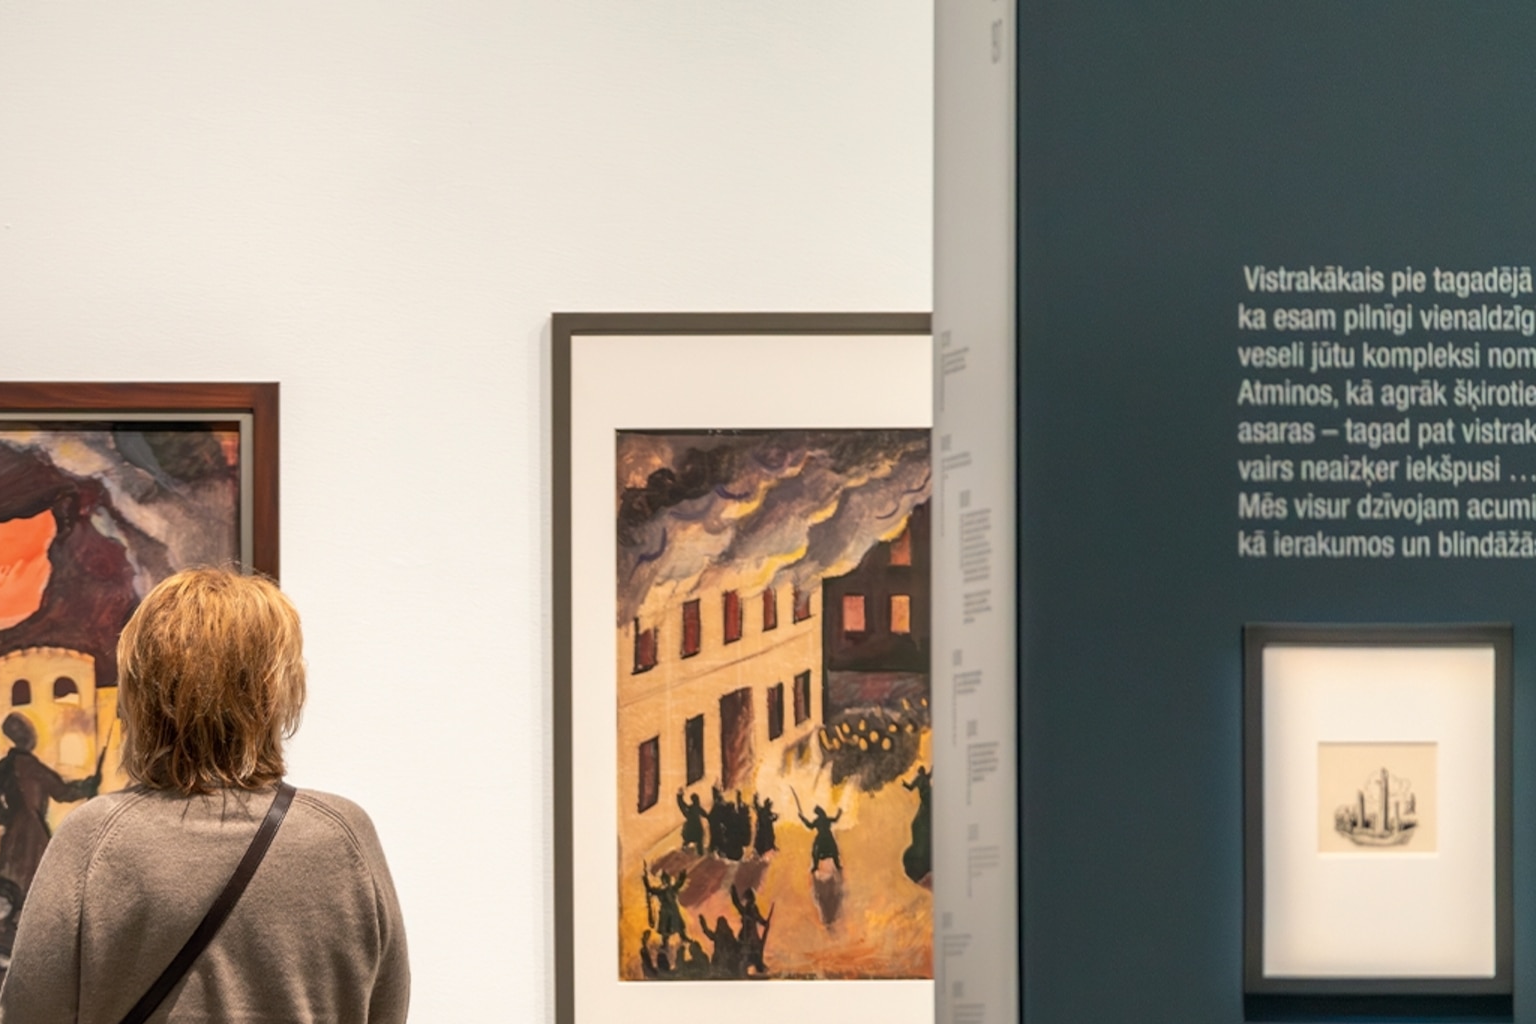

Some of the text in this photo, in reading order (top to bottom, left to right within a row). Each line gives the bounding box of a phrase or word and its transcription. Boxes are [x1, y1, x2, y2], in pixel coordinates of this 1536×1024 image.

[1244, 265, 1533, 298] Vistrakākais pie tagadējā
[1238, 303, 1266, 330] ka
[1273, 308, 1336, 330] esam
[1344, 303, 1412, 336] pilnīgi
[1238, 341, 1304, 368] veseli
[1310, 341, 1355, 373] jūtu
[1363, 342, 1480, 373] kompleksi
[1237, 379, 1536, 412] Atminos, kā agrāk šķirotie
[1238, 422, 1315, 443] asaras
[1344, 418, 1410, 449] tagad
[1418, 418, 1455, 449] pat
[1238, 455, 1294, 481] vairs
[1301, 455, 1399, 487] neaizķer
[1406, 454, 1500, 487] iekšpusi
[1239, 492, 1288, 519] Mēs
[1294, 493, 1351, 519] visur
[1357, 493, 1459, 525] dzīvojam
[1239, 530, 1536, 558] kā ierakumos un blindāžā
